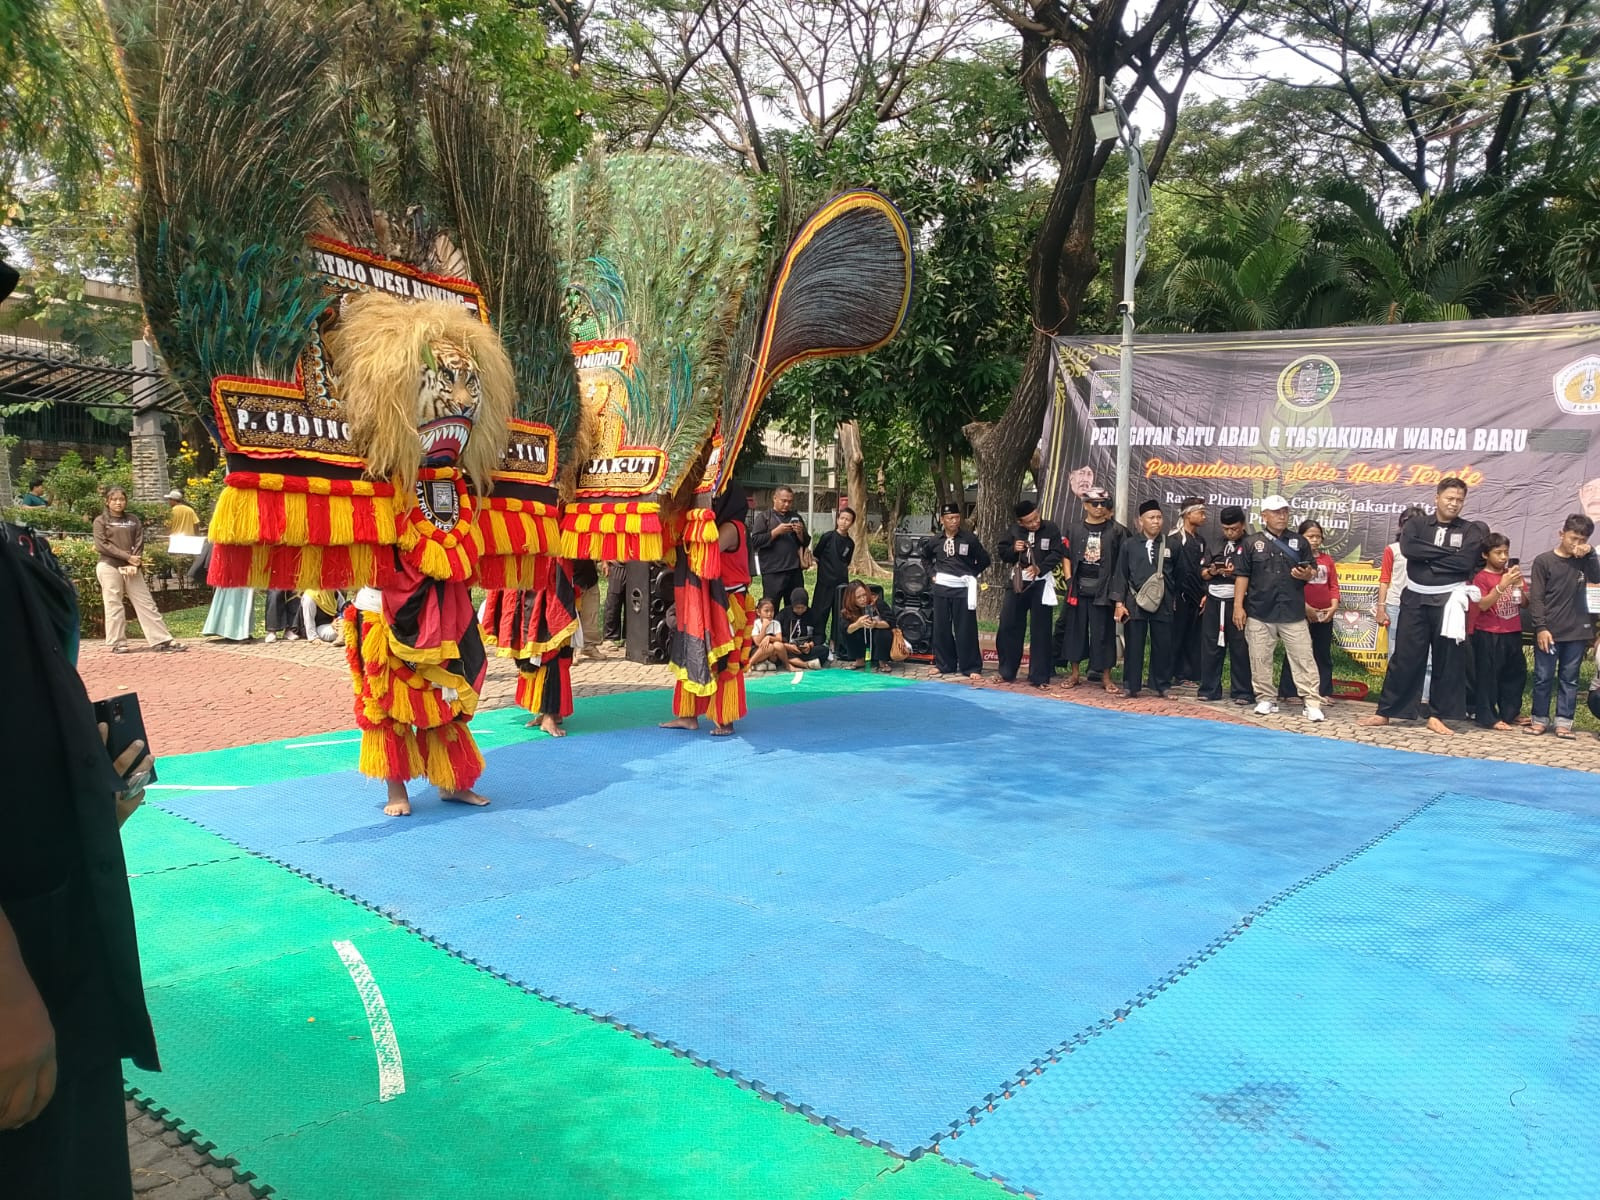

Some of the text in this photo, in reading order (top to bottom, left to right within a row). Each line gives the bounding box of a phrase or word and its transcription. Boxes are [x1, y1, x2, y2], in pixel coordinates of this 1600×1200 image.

[313, 251, 367, 283] ATRIO
[369, 268, 410, 296] WESI
[580, 350, 621, 367] MUDHO
[237, 408, 258, 430] P.
[1090, 426, 1528, 452] PERIGATAN SATU ABAD & TASYAKURAN WARGA BARU
[588, 456, 655, 474] JAK-UT
[416, 481, 433, 520] SATRIO
[1208, 493, 1263, 510] Plumpa
[1291, 497, 1347, 514] Cabang
[1350, 499, 1407, 514] Jakarta
